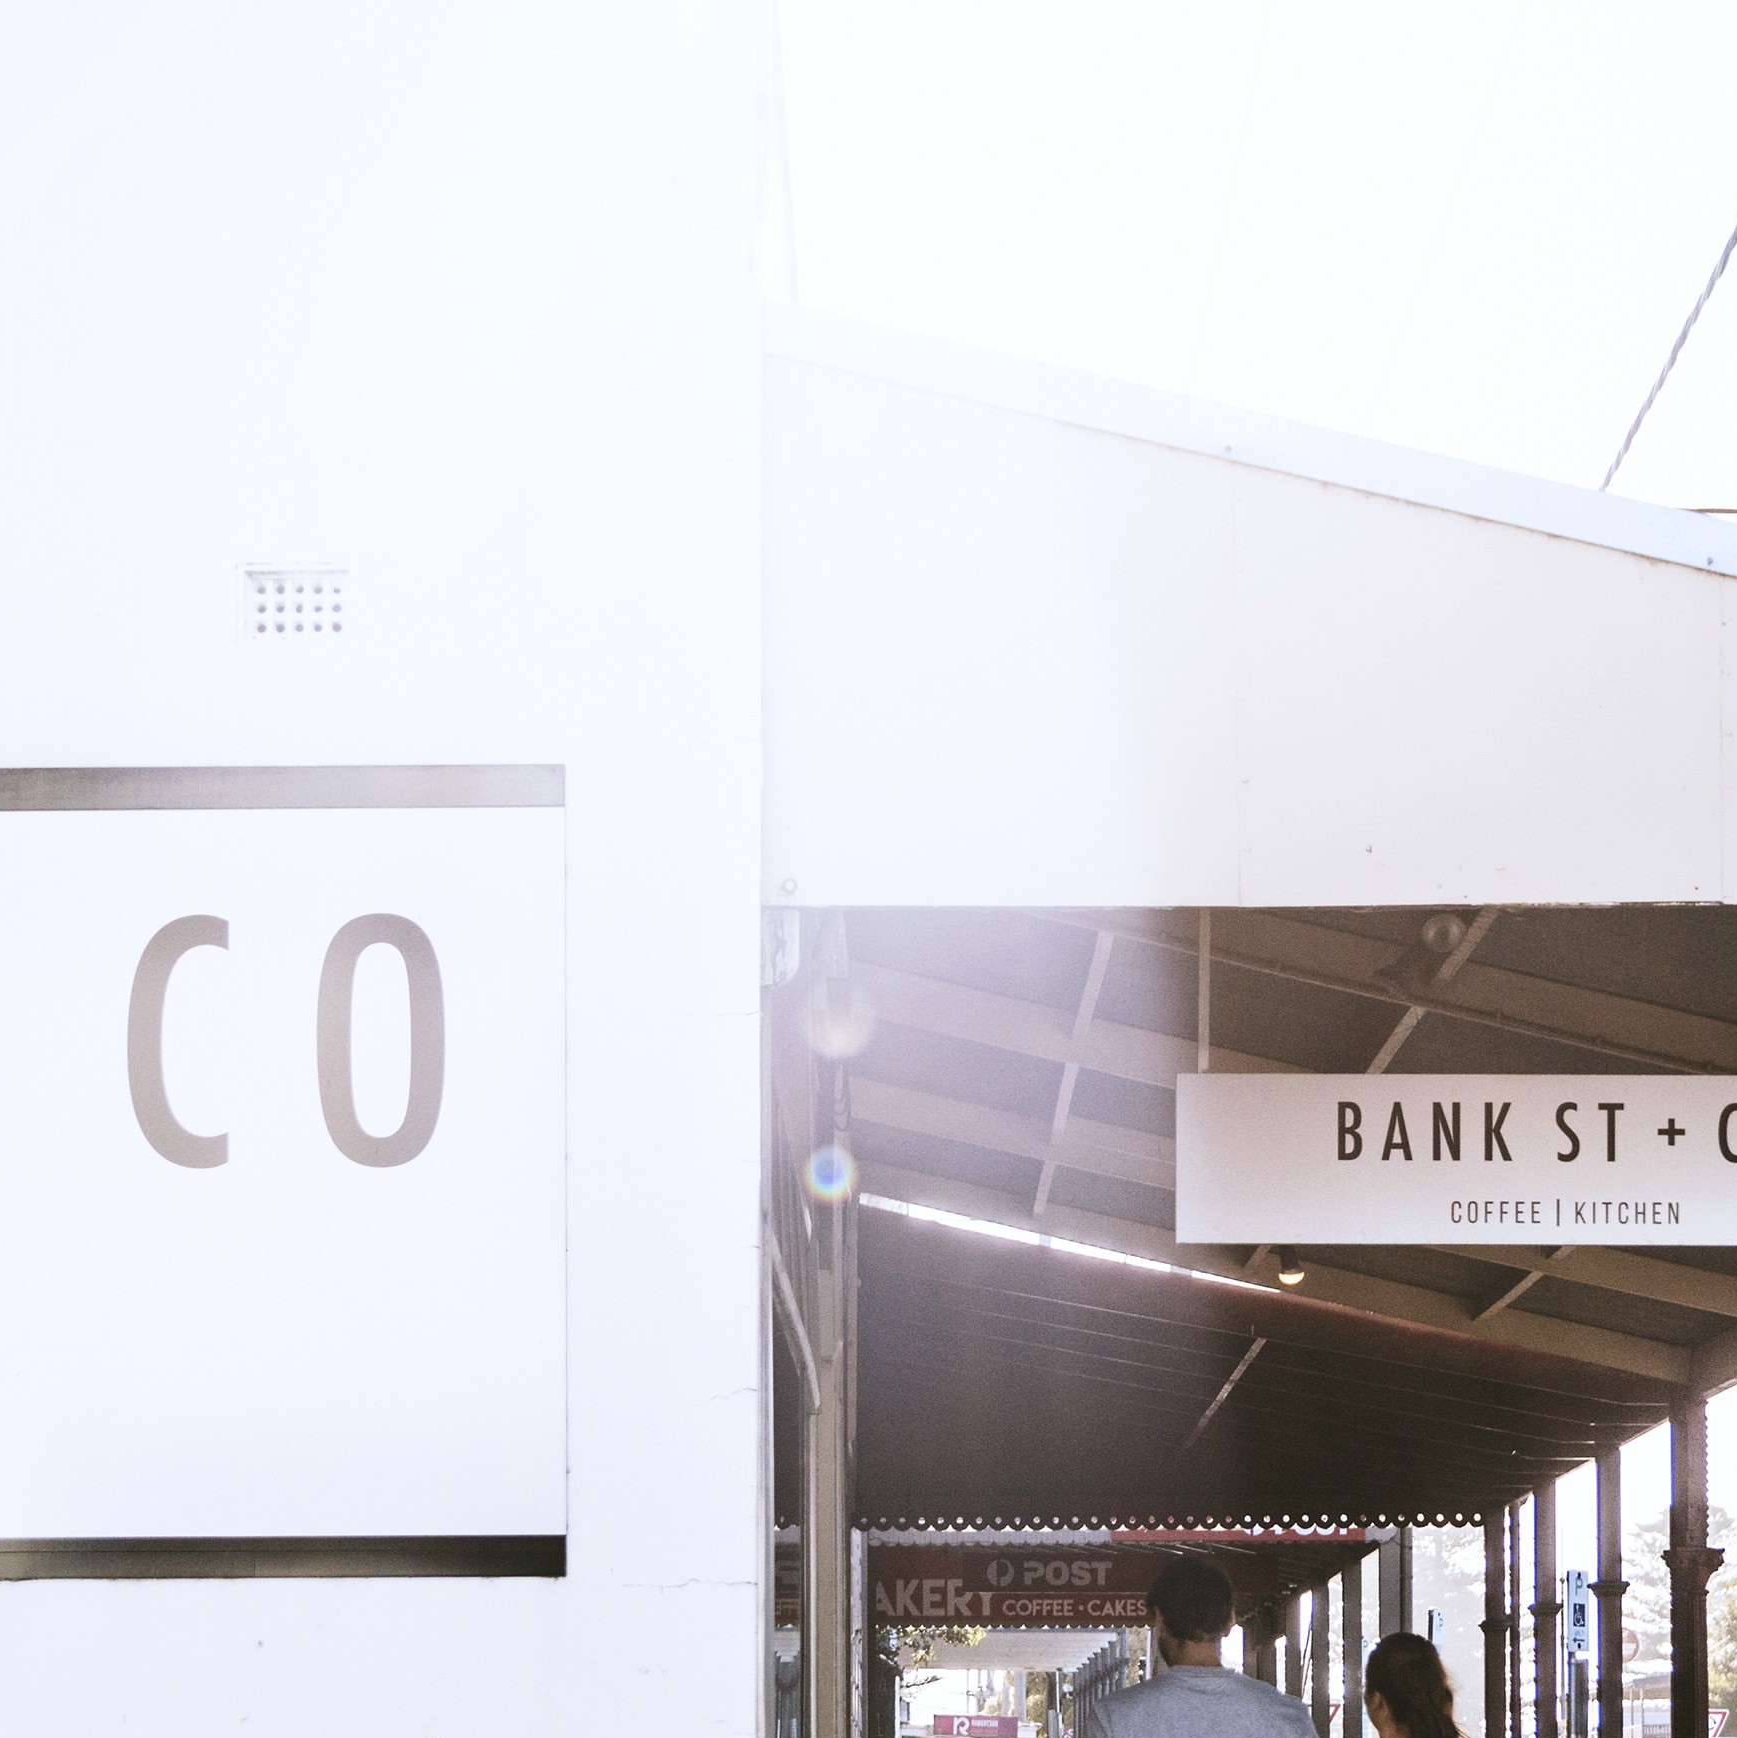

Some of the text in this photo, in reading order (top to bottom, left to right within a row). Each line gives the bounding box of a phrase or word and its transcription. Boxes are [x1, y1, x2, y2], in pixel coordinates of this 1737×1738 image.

[128, 914, 444, 1168] CO
[1337, 1101, 1513, 1162] BANK
[1555, 1101, 1625, 1163] ST
[1657, 1117, 1686, 1147] +
[1451, 1200, 1541, 1225] COFFEE
[1574, 1200, 1680, 1226] KITCHEN
[1023, 1560, 1112, 1586] POST
[1002, 1600, 1074, 1616] COFFEE
[1087, 1600, 1148, 1616] CAKES
